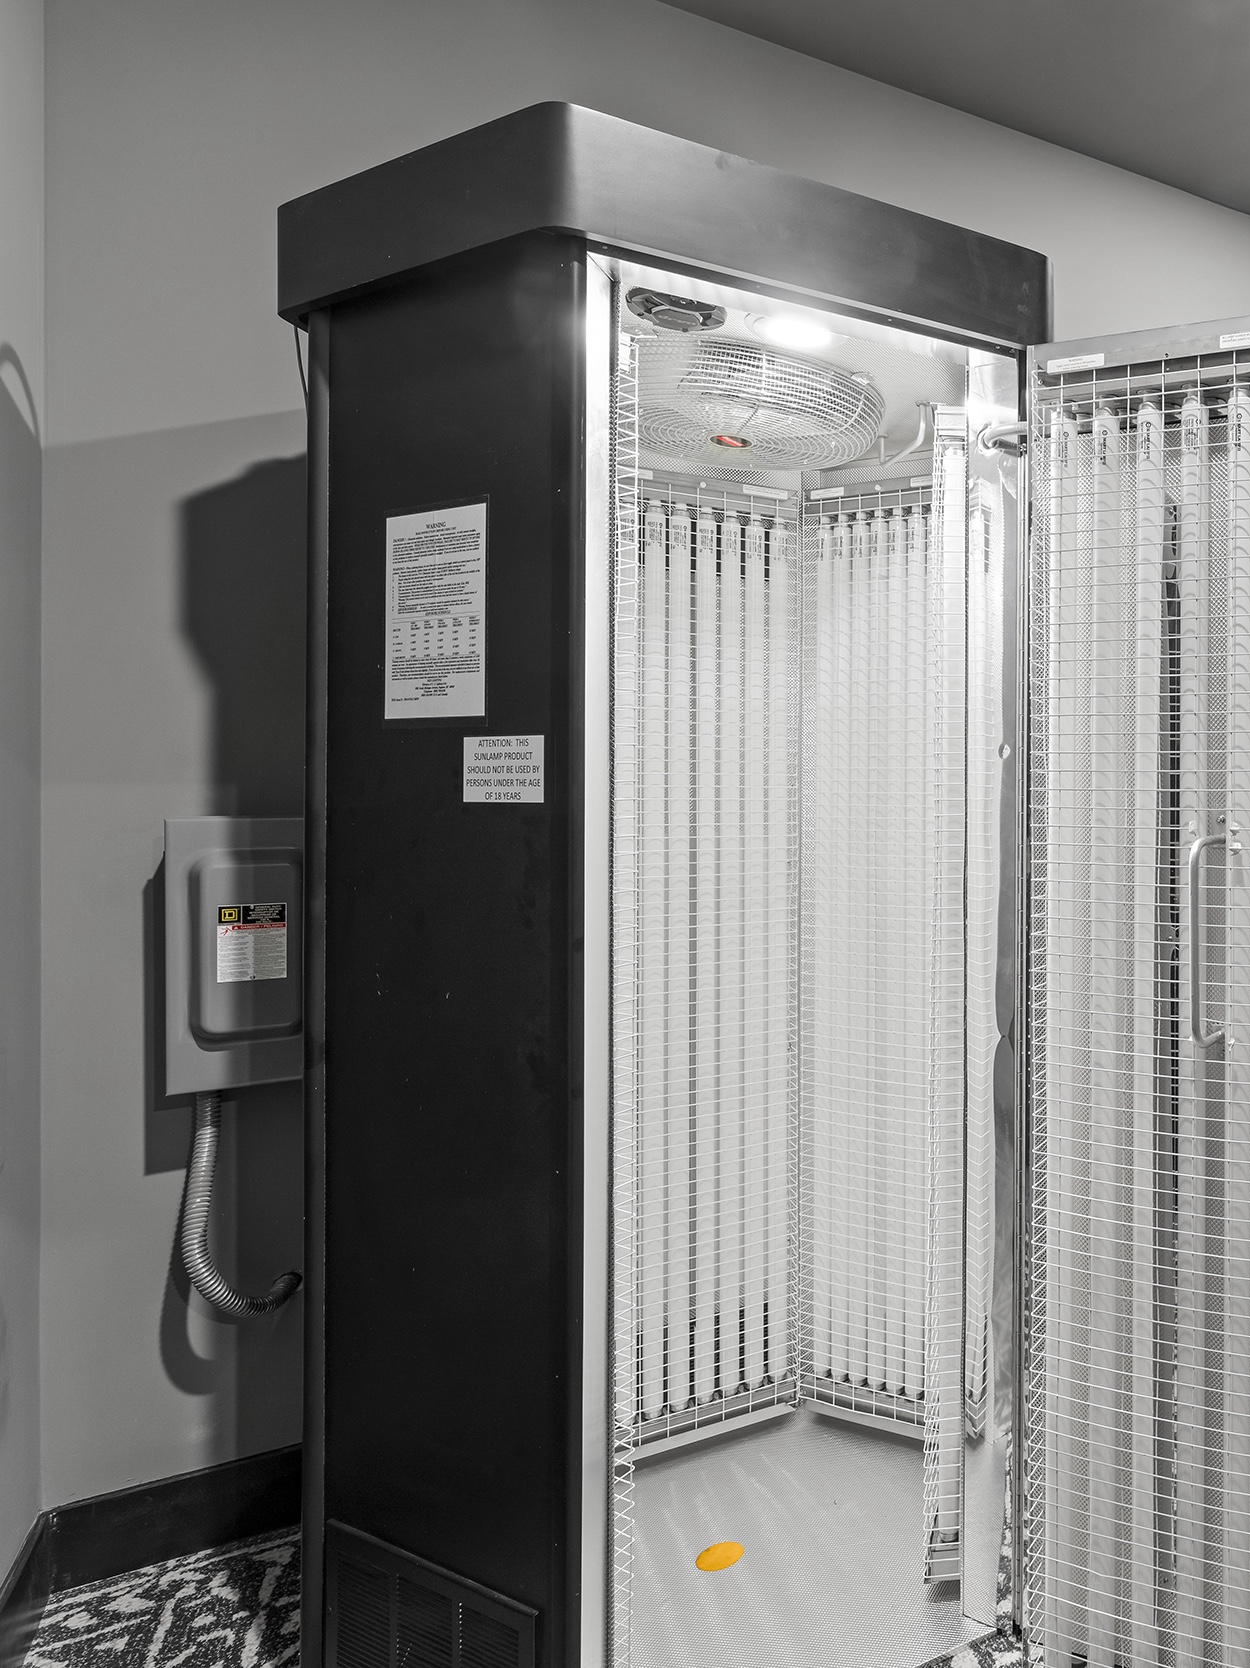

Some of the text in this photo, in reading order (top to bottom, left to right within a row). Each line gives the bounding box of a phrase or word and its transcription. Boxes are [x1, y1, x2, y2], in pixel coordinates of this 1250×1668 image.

[478, 738, 529, 748] ATTENTION: THIS
[474, 751, 533, 761] SUNLAMP PRODUCT
[467, 765, 540, 774] SHOULD NOT BE USED BY
[466, 778, 541, 787] PERSONS UNDER THE AGE
[484, 792, 522, 800] OF 18 YEARS
